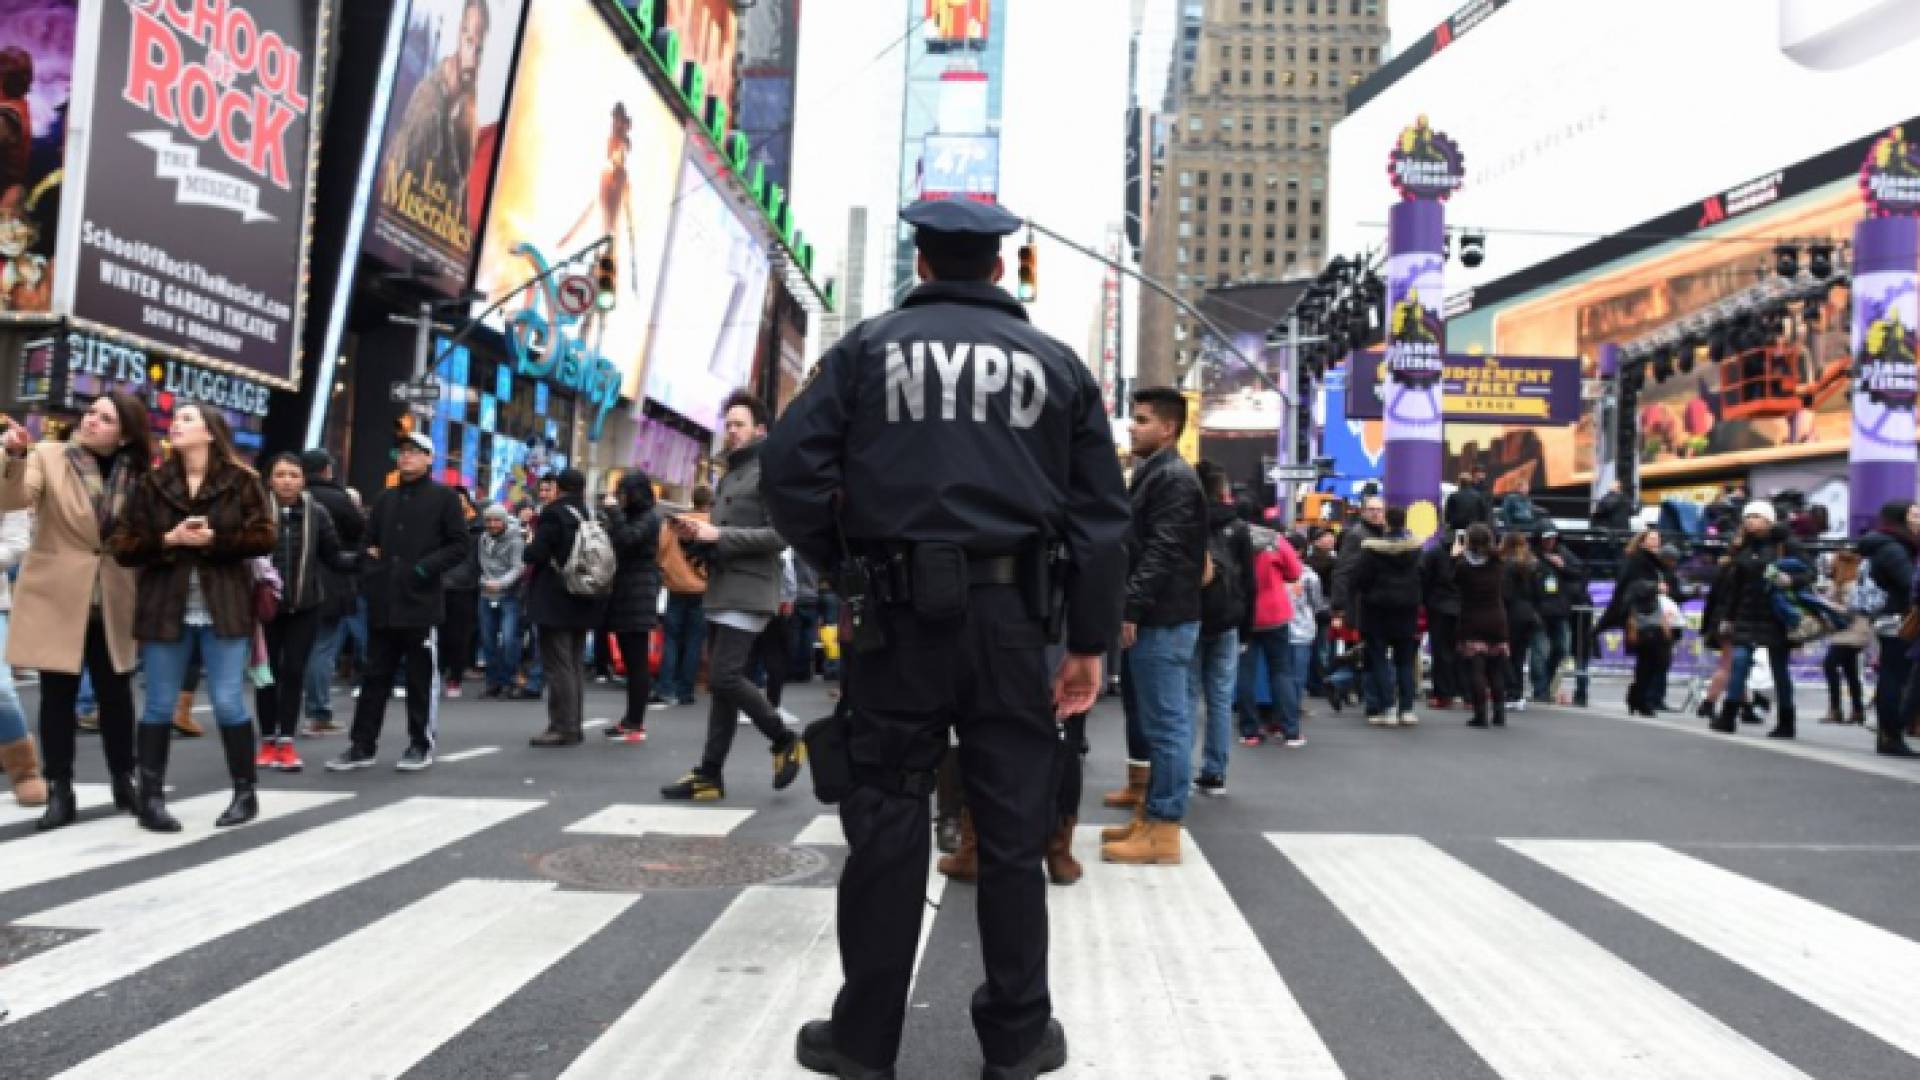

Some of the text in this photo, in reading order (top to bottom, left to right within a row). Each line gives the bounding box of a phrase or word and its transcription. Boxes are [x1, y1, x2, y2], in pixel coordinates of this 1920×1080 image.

[122, 4, 294, 190] ROCK
[127, 0, 308, 113] CHOOL
[164, 151, 189, 168] THE
[184, 174, 252, 205] MUSICAL
[100, 258, 277, 343] WINTER GARDEN THEATRE
[68, 332, 270, 416] GIFTS LUGGAGE
[885, 340, 1048, 429] NYPD
[1442, 366, 1551, 383] UDGEMENT
[1465, 382, 1516, 395] FREE
